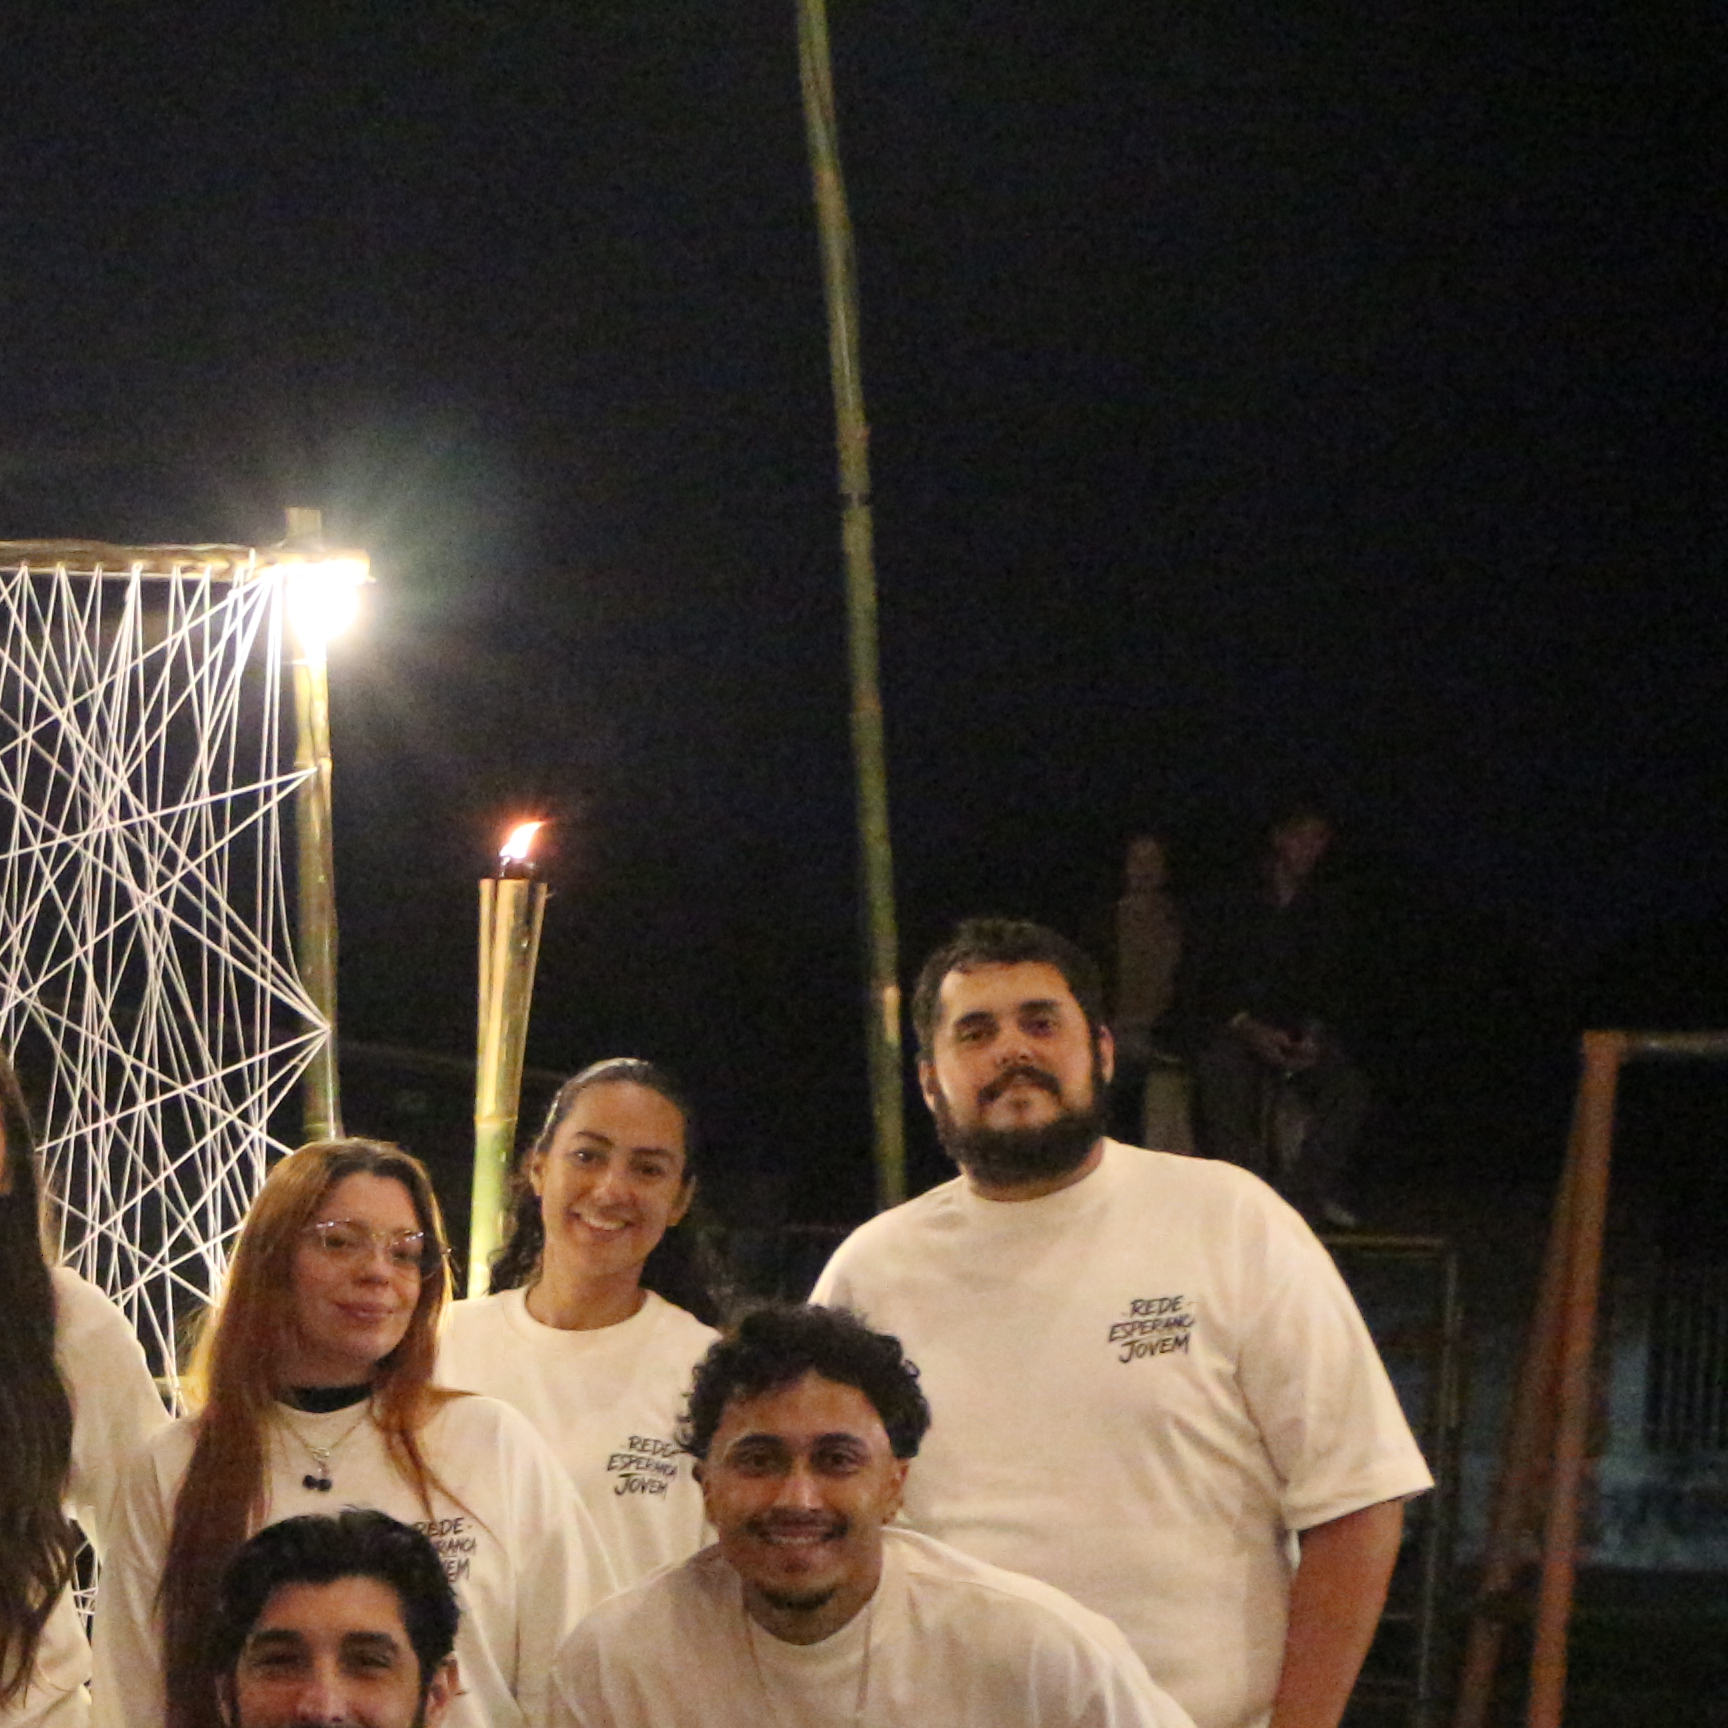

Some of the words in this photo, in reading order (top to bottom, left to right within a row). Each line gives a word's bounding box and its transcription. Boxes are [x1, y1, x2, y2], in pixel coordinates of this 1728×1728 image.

[1130, 1295, 1184, 1317] REDE
[1119, 1332, 1191, 1363] JOVEM
[628, 1435, 672, 1457] REDE
